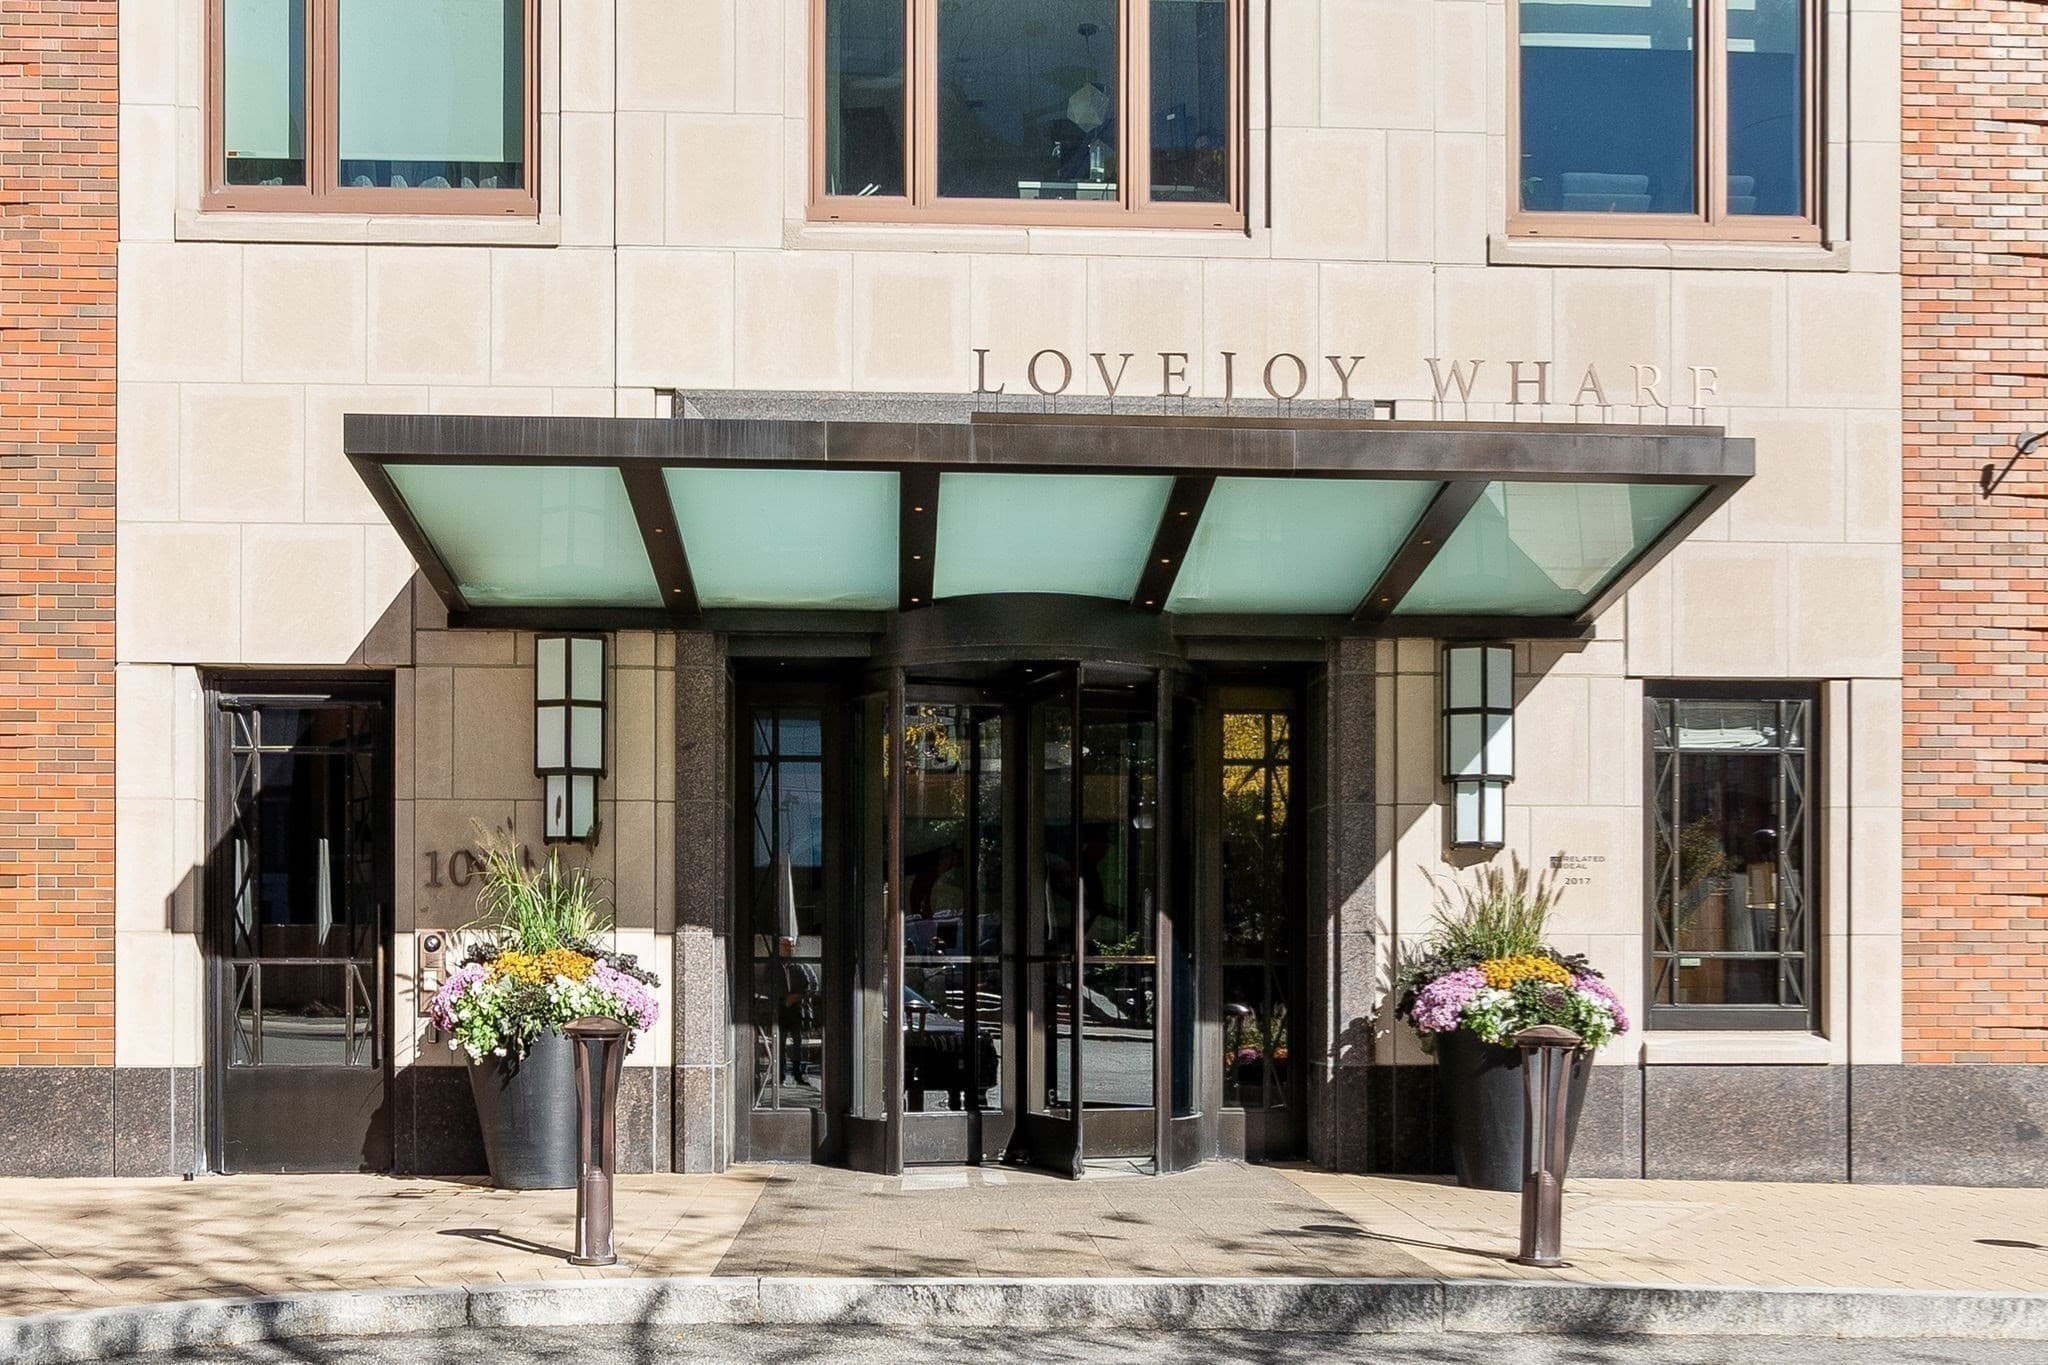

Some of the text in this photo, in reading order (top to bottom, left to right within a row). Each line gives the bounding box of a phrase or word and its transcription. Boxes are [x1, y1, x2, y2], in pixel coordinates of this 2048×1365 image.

[972, 348, 1720, 409] LOVEJOY WHARF
[1564, 877, 1591, 885] 2017
